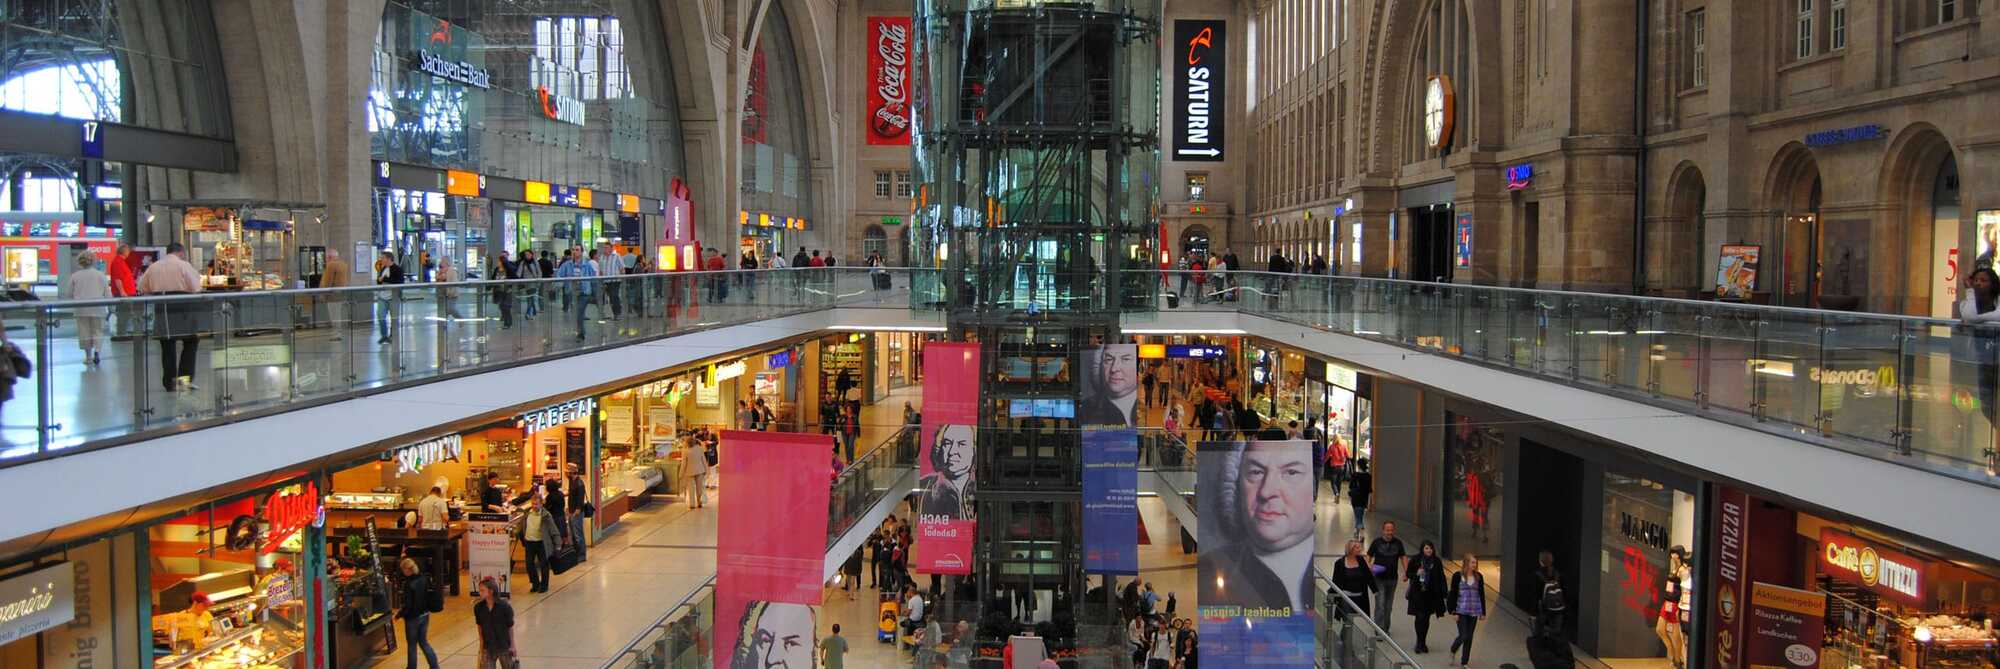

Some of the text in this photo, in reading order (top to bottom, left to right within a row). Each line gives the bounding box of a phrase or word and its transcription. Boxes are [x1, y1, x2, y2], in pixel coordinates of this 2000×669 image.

[420, 48, 490, 89] Sachsen Bank
[878, 23, 906, 103] Coca-Cola
[556, 95, 585, 127] SATURN
[1187, 66, 1210, 144] SATURN
[83, 122, 97, 142] 17
[380, 162, 390, 178] 18
[1621, 512, 1668, 551] MANGO
[1720, 502, 1740, 581] RITAZZA
[69, 638, 98, 669] nig
